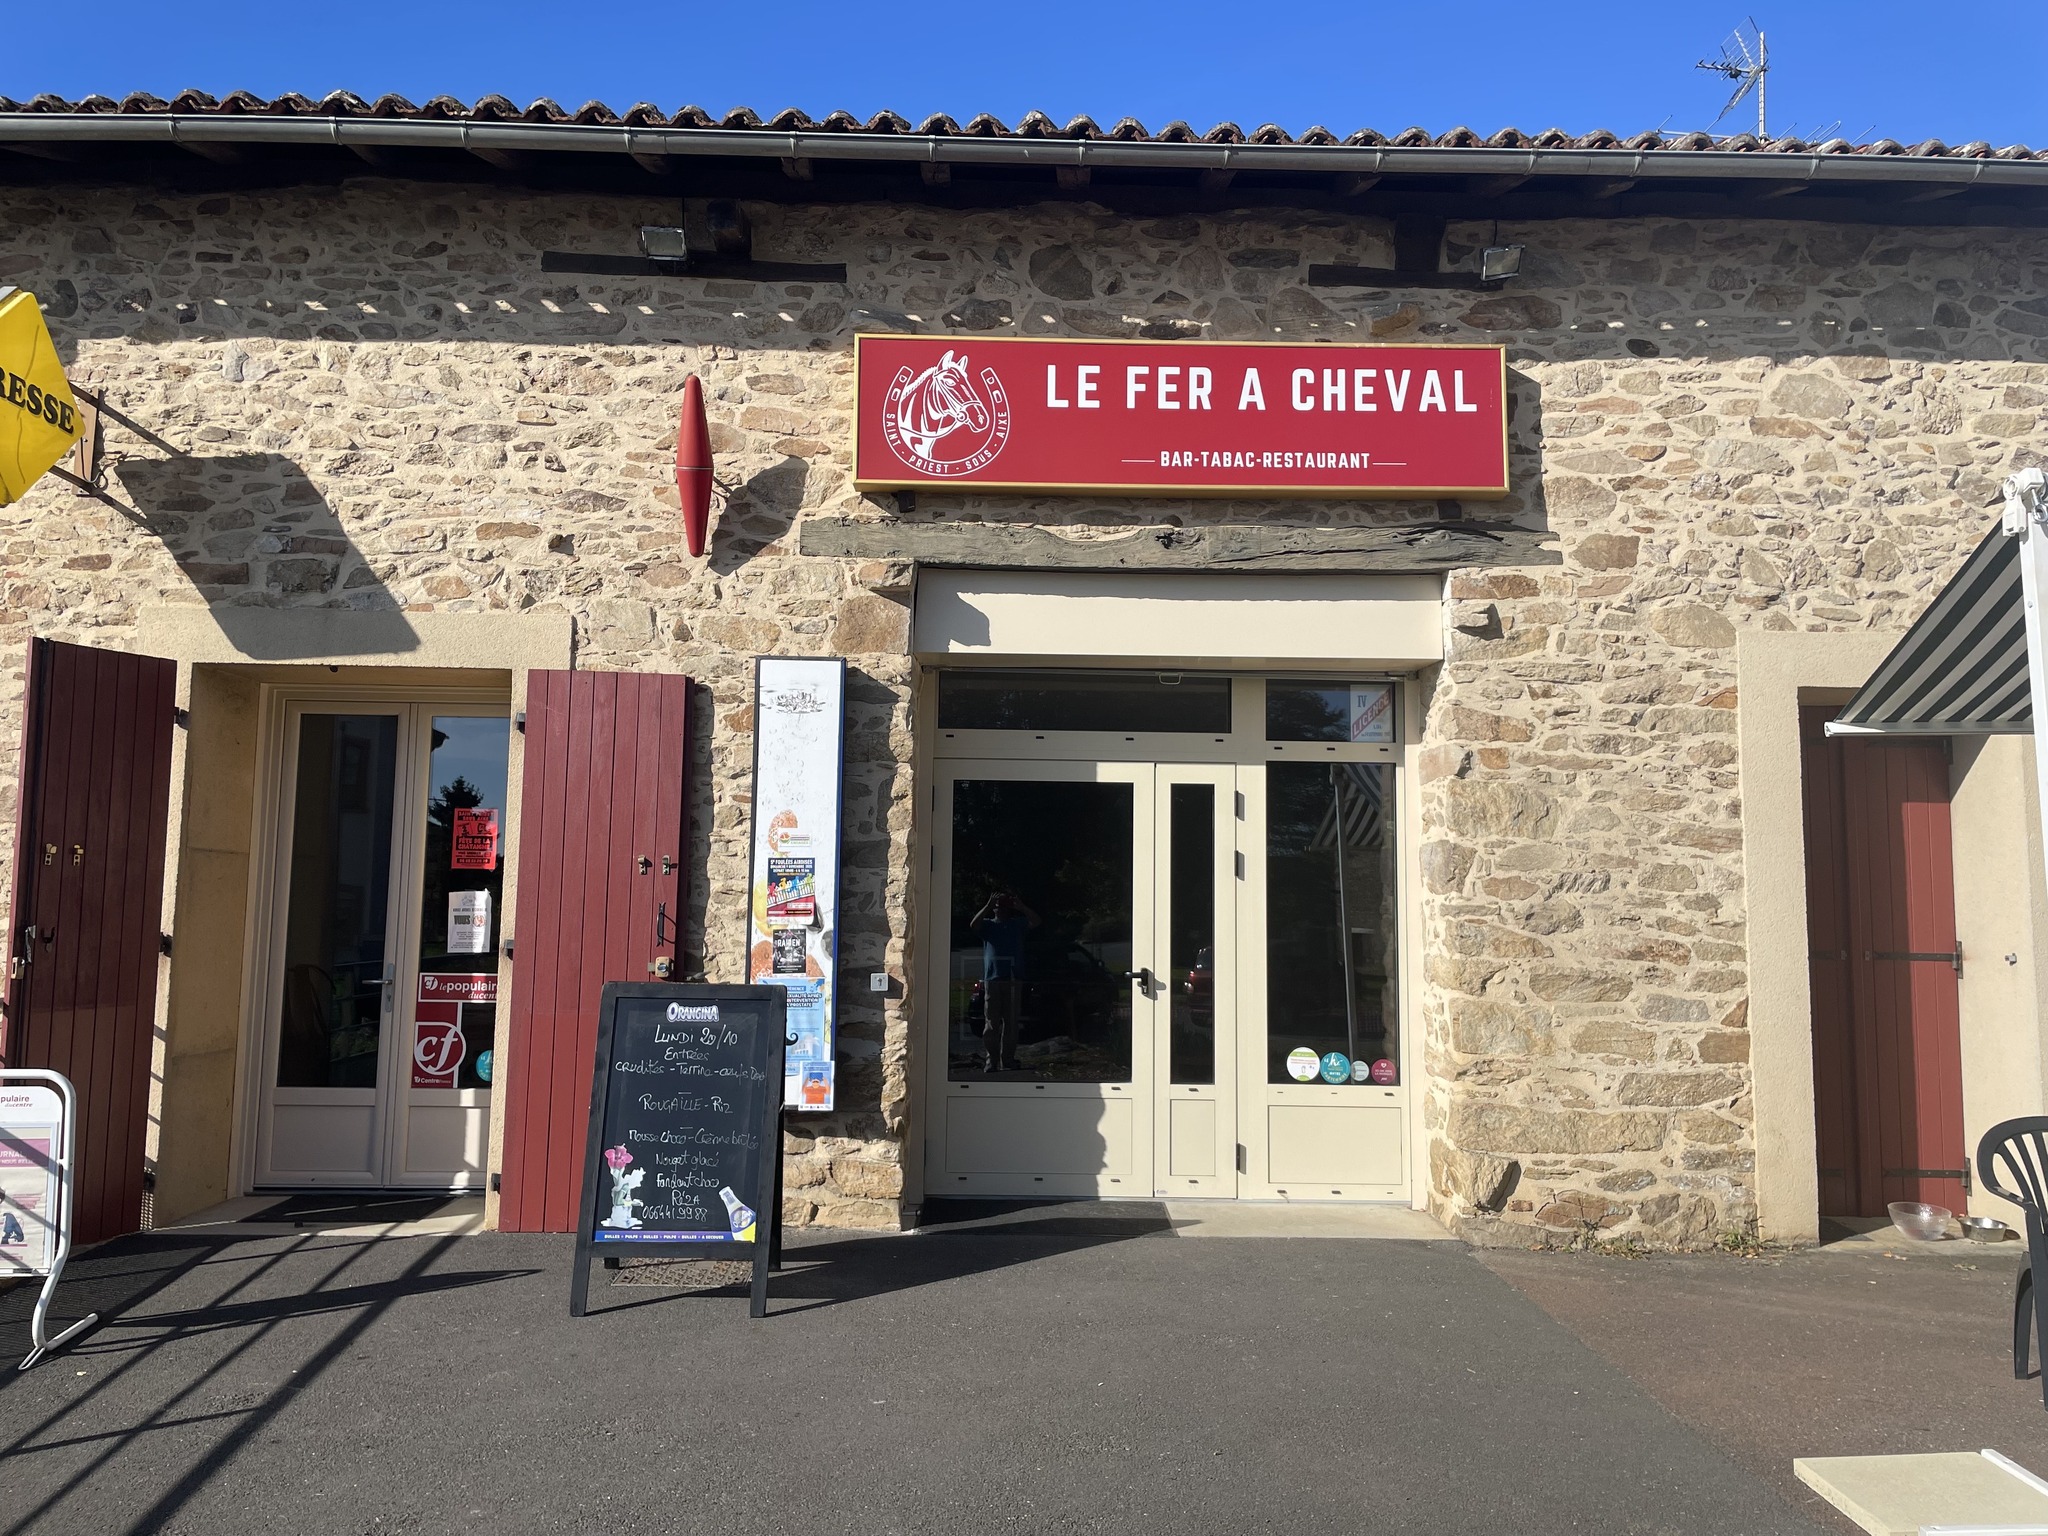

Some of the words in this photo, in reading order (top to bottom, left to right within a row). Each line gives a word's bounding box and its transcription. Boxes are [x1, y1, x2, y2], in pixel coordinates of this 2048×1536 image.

[1046, 364, 1101, 409] LE
[1125, 365, 1213, 411] FER
[1238, 367, 1267, 412] A
[1291, 367, 1479, 413] CHEVAL
[886, 413, 901, 447] SAINT
[908, 454, 949, 474] PRIEST
[965, 449, 992, 470] SOUS
[996, 411, 1008, 439] AIXE
[1159, 450, 1370, 469] BAR-TABAC-RESTAURANT
[1353, 690, 1390, 736] LICENCE
[1357, 694, 1368, 708] IV
